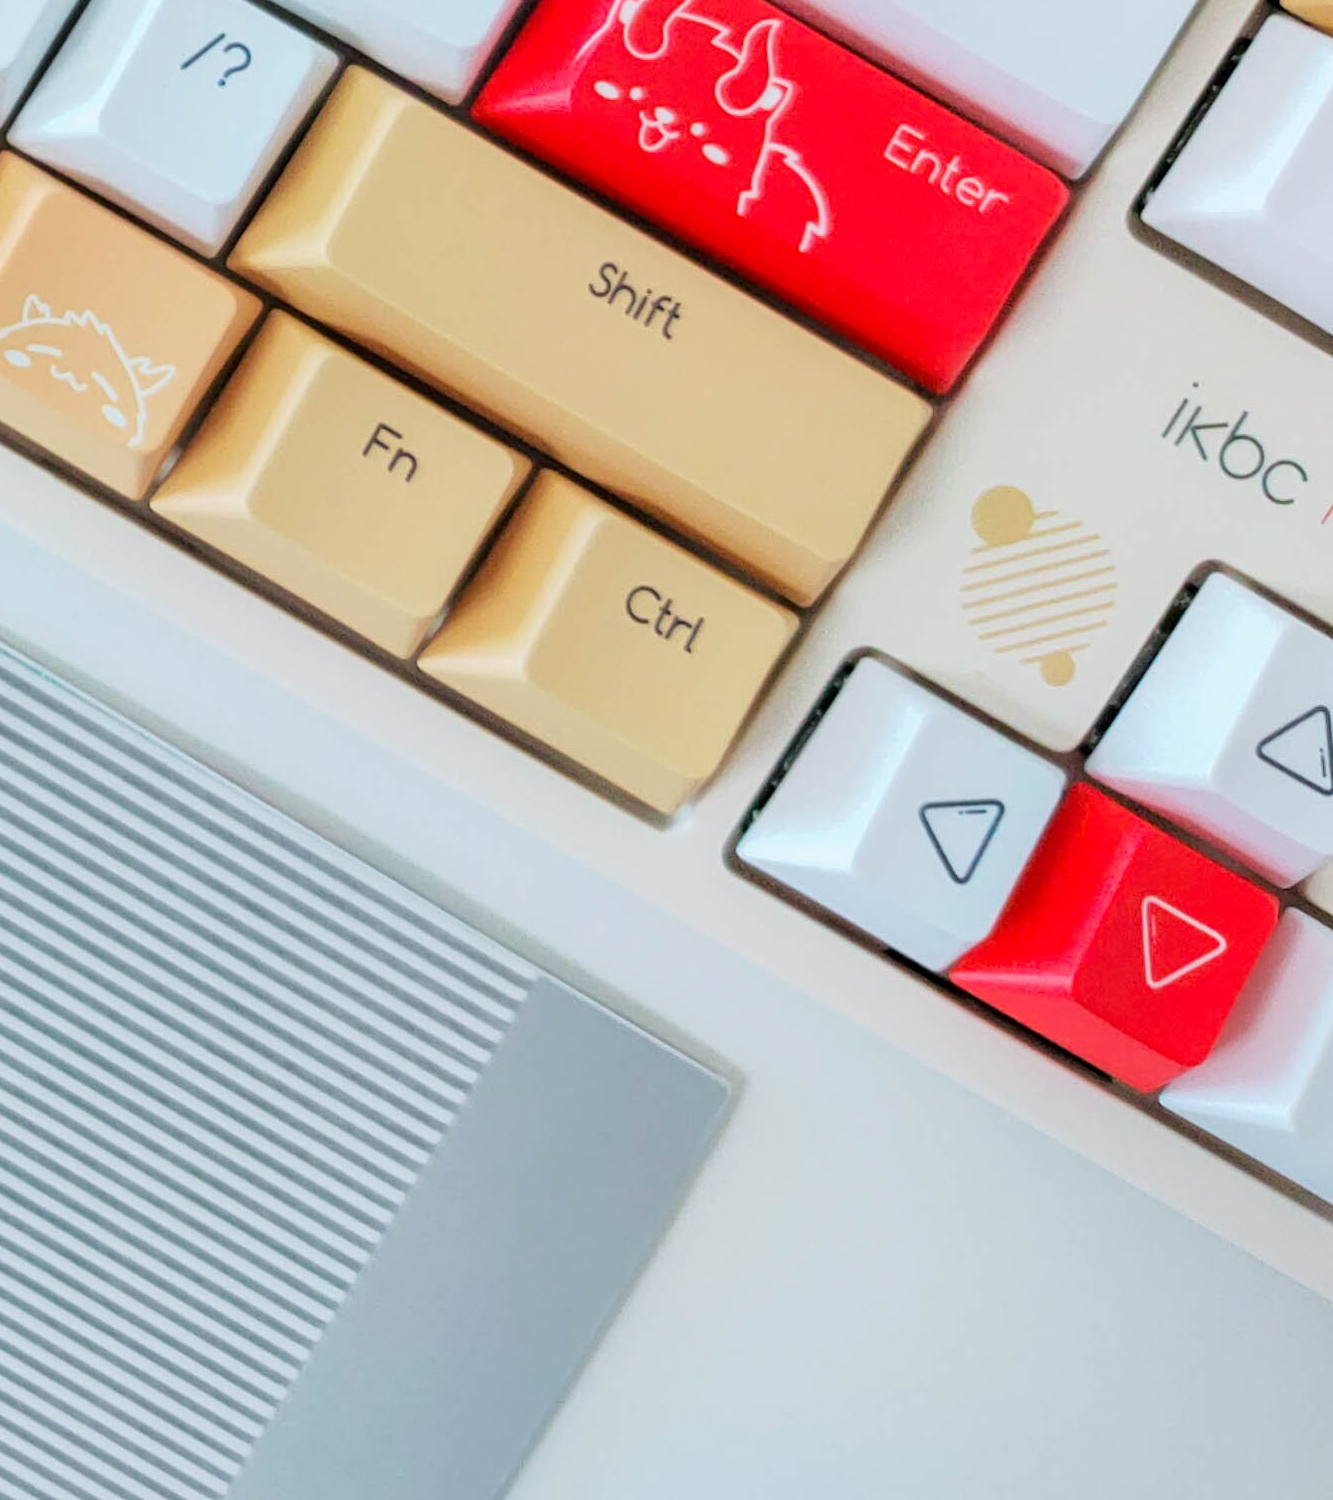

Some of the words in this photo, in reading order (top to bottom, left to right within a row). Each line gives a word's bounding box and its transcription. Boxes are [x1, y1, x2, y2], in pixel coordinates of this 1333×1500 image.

[180, 32, 252, 87] /?
[882, 122, 1009, 214] Enter
[588, 262, 682, 341] Shift
[362, 422, 418, 483] Fn
[1161, 382, 1309, 506] ikbc
[625, 585, 705, 654] Ctrl
